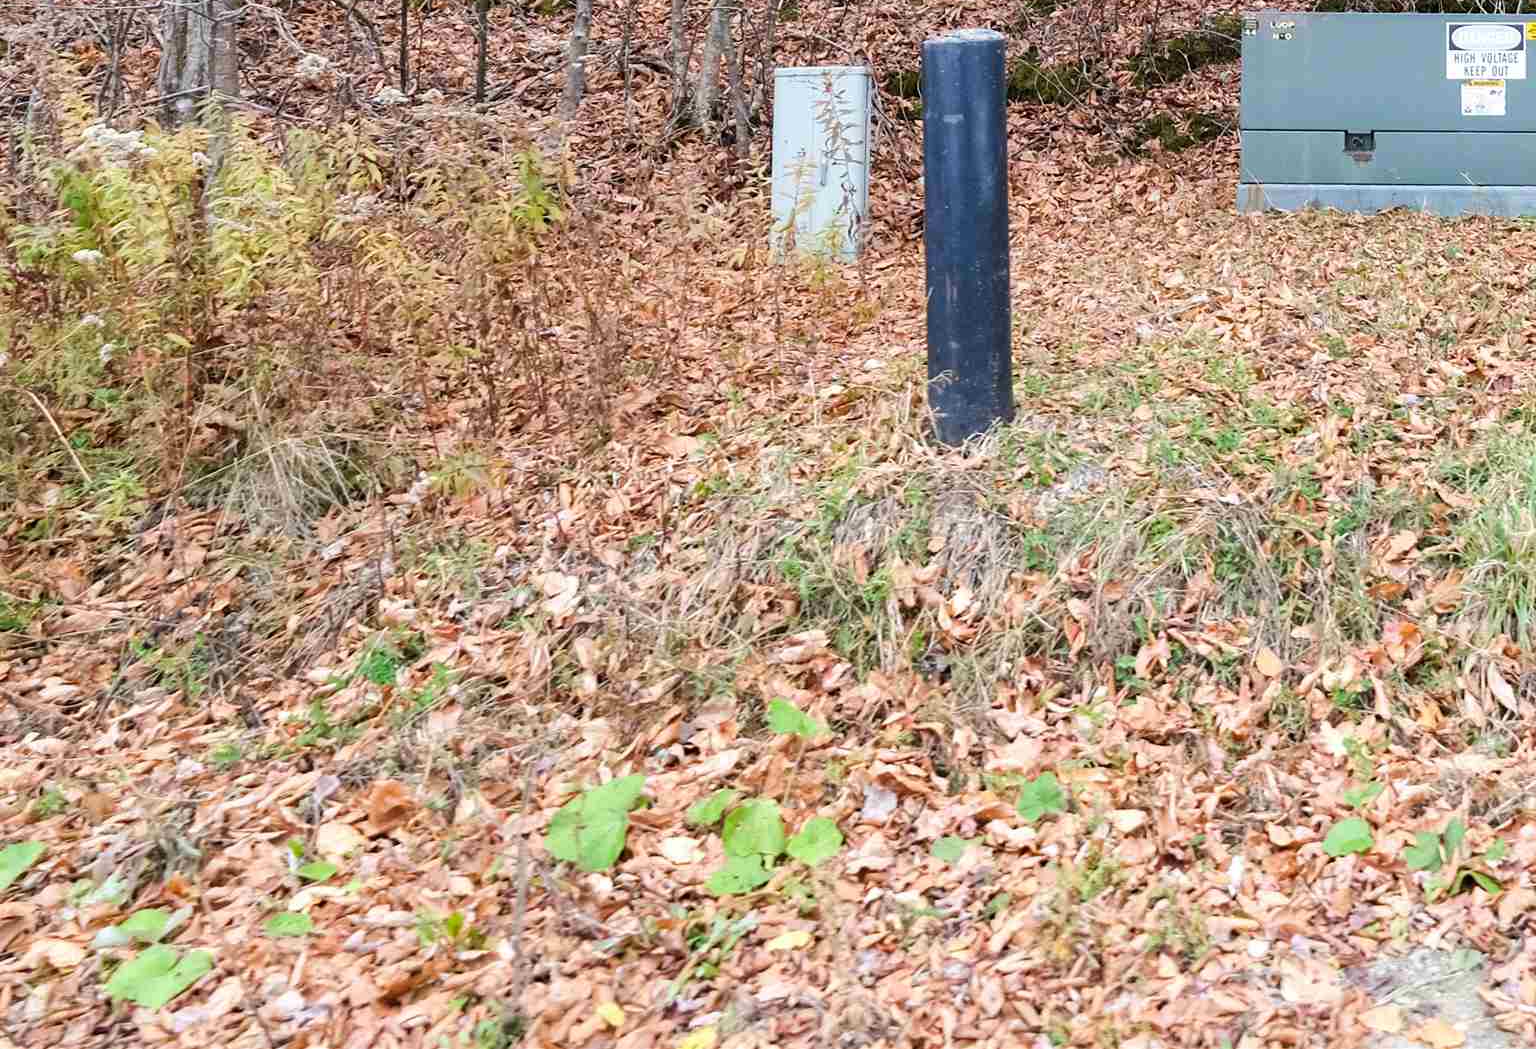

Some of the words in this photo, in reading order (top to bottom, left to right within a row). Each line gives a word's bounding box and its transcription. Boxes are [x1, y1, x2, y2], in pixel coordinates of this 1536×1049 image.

[1454, 53, 1476, 64] HIGH
[1481, 53, 1519, 64] VOLTAGE
[1464, 66, 1487, 77] KEEP
[1492, 66, 1510, 77] OUT
